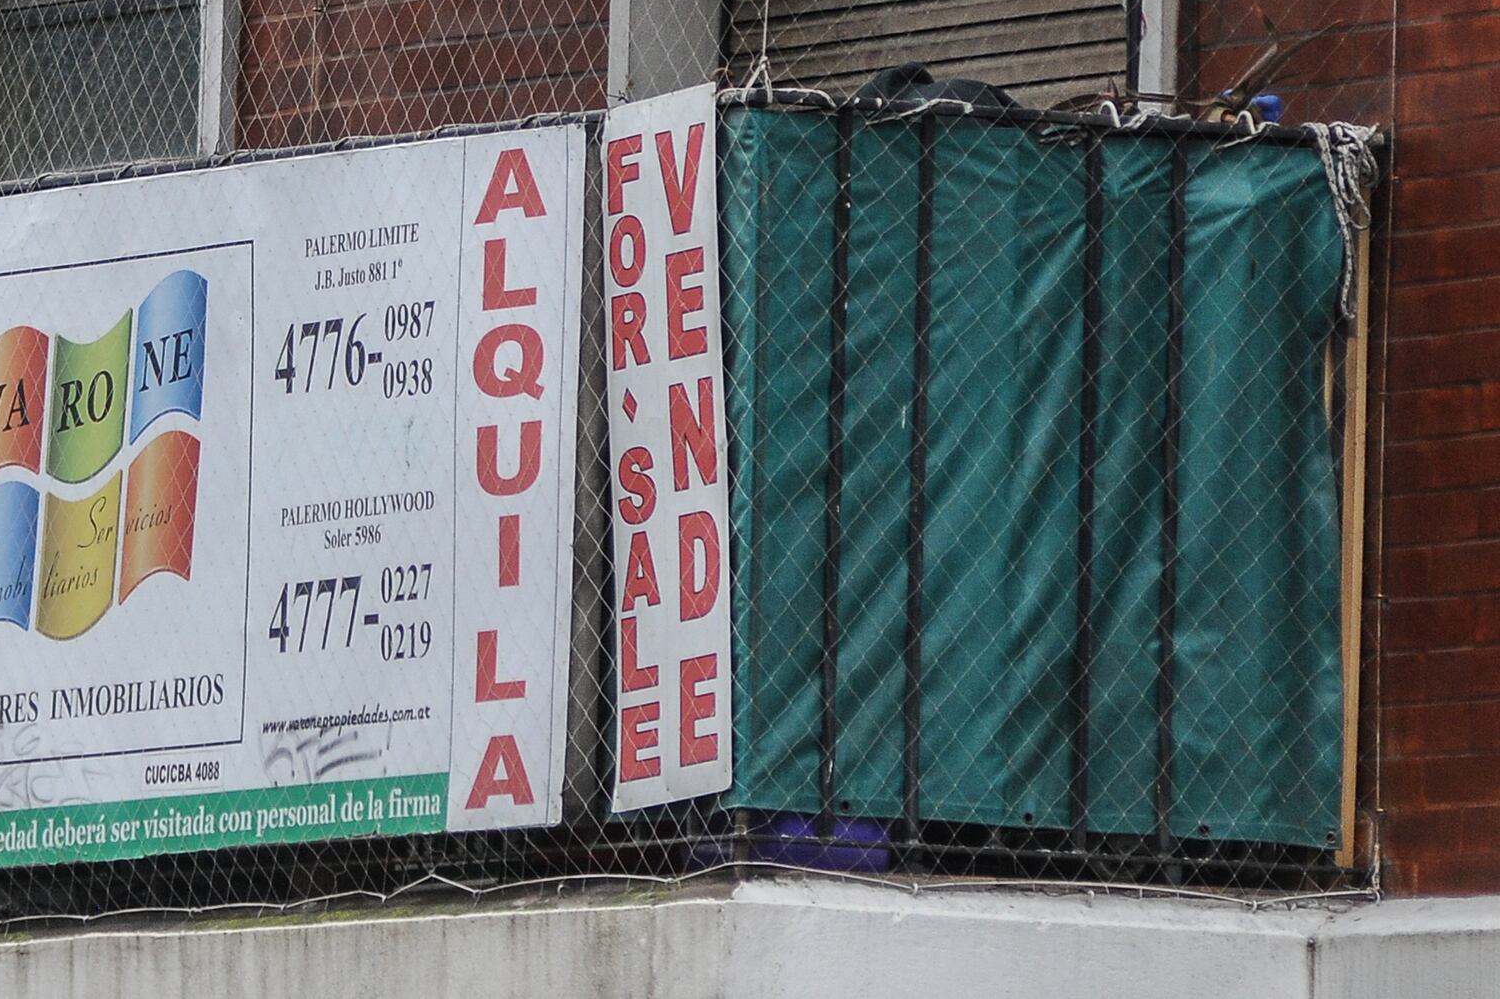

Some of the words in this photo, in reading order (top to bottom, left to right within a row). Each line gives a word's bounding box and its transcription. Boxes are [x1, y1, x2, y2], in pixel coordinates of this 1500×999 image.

[305, 230, 366, 258] PALERMO
[369, 222, 419, 248] LIMITE
[607, 134, 651, 371] FOR
[314, 269, 336, 290] J.B.
[338, 267, 366, 288] Justo
[368, 261, 387, 283] 881
[383, 358, 433, 400] 0938
[655, 122, 721, 768] VENDE
[464, 147, 547, 810] ALQUILA
[281, 500, 341, 527] PALERMO
[344, 490, 435, 519] HOLLYWOOD
[324, 529, 352, 550] Soler
[354, 524, 381, 546] 5986
[380, 563, 433, 604] 0227
[618, 446, 661, 783] SALE
[380, 620, 432, 661] 0219
[50, 673, 225, 720] INMOBILIARIOS
[144, 763, 192, 785] CUCICBA
[195, 760, 220, 781] 4088
[42, 814, 106, 848] deberá
[109, 820, 141, 843] ser
[143, 805, 214, 840] visitada
[218, 810, 252, 833] con
[255, 794, 336, 837] personal
[340, 793, 363, 821] de
[367, 790, 383, 819] la
[388, 788, 442, 818] firma
